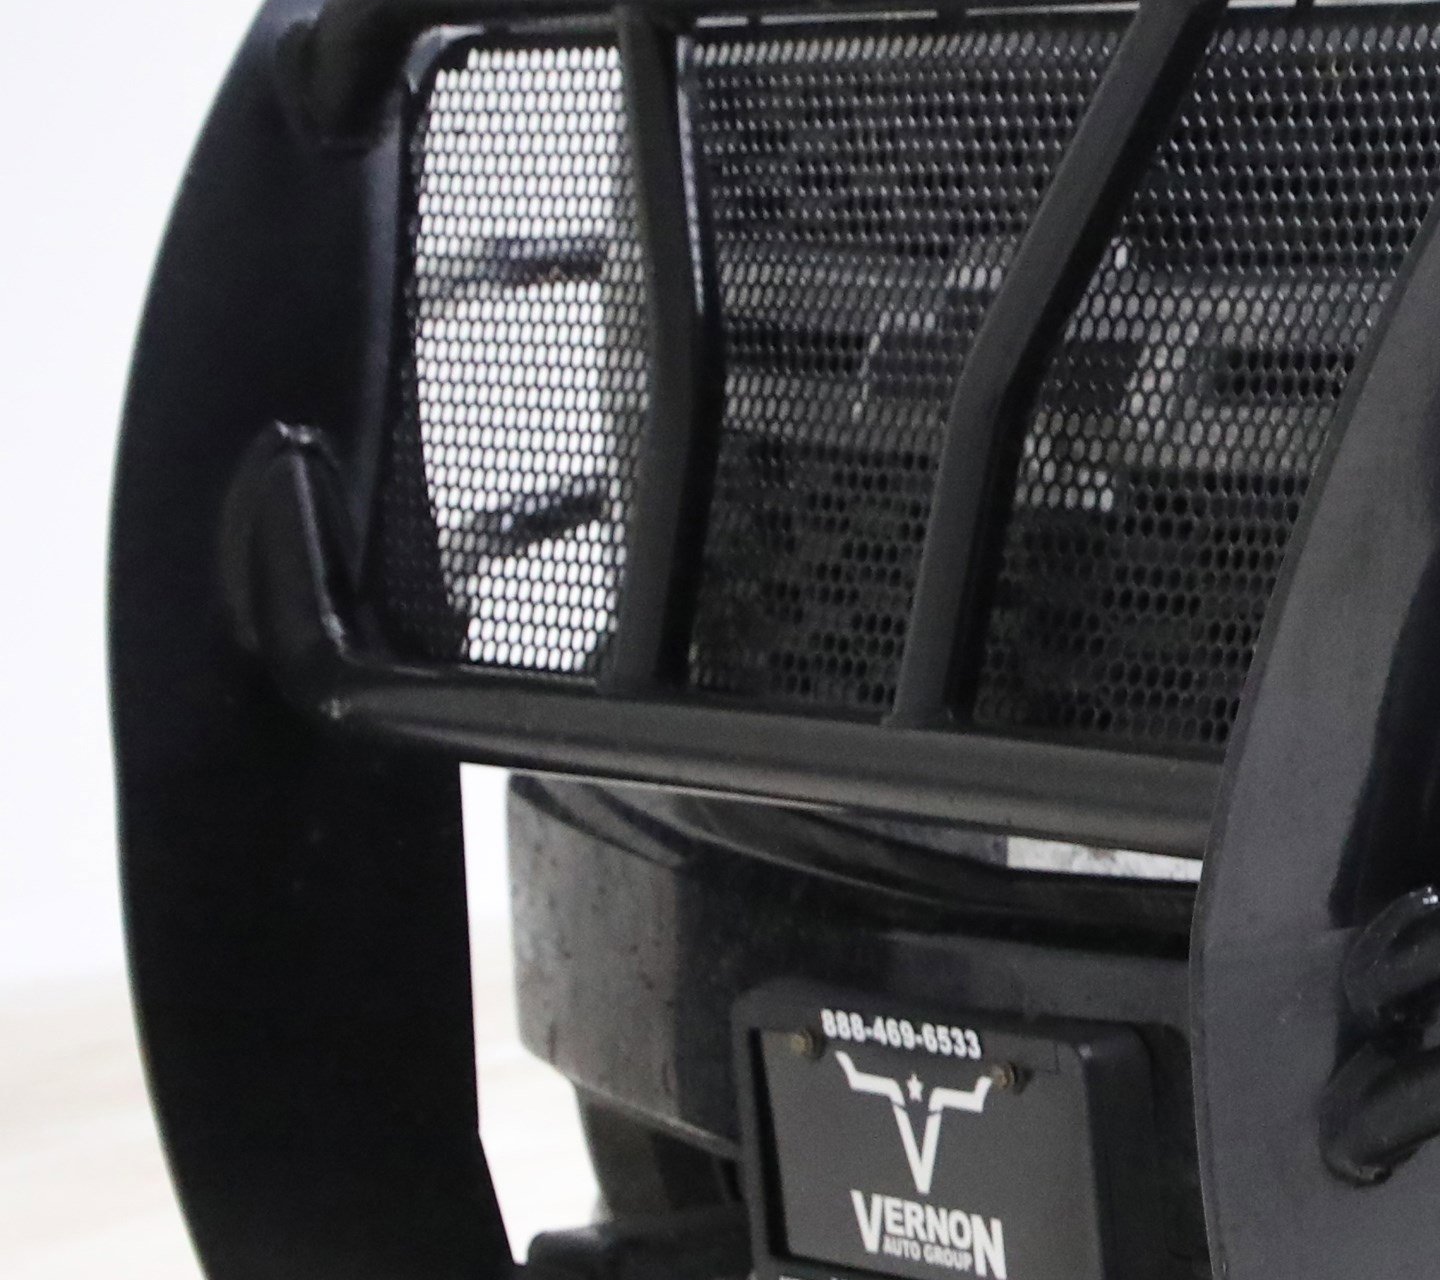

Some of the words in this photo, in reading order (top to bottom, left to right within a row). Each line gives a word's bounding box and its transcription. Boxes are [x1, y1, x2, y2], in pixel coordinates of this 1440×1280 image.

[820, 1008, 982, 1060] 888-469-6533
[883, 1239, 920, 1262] AUTO
[924, 1246, 973, 1272] GROUP
